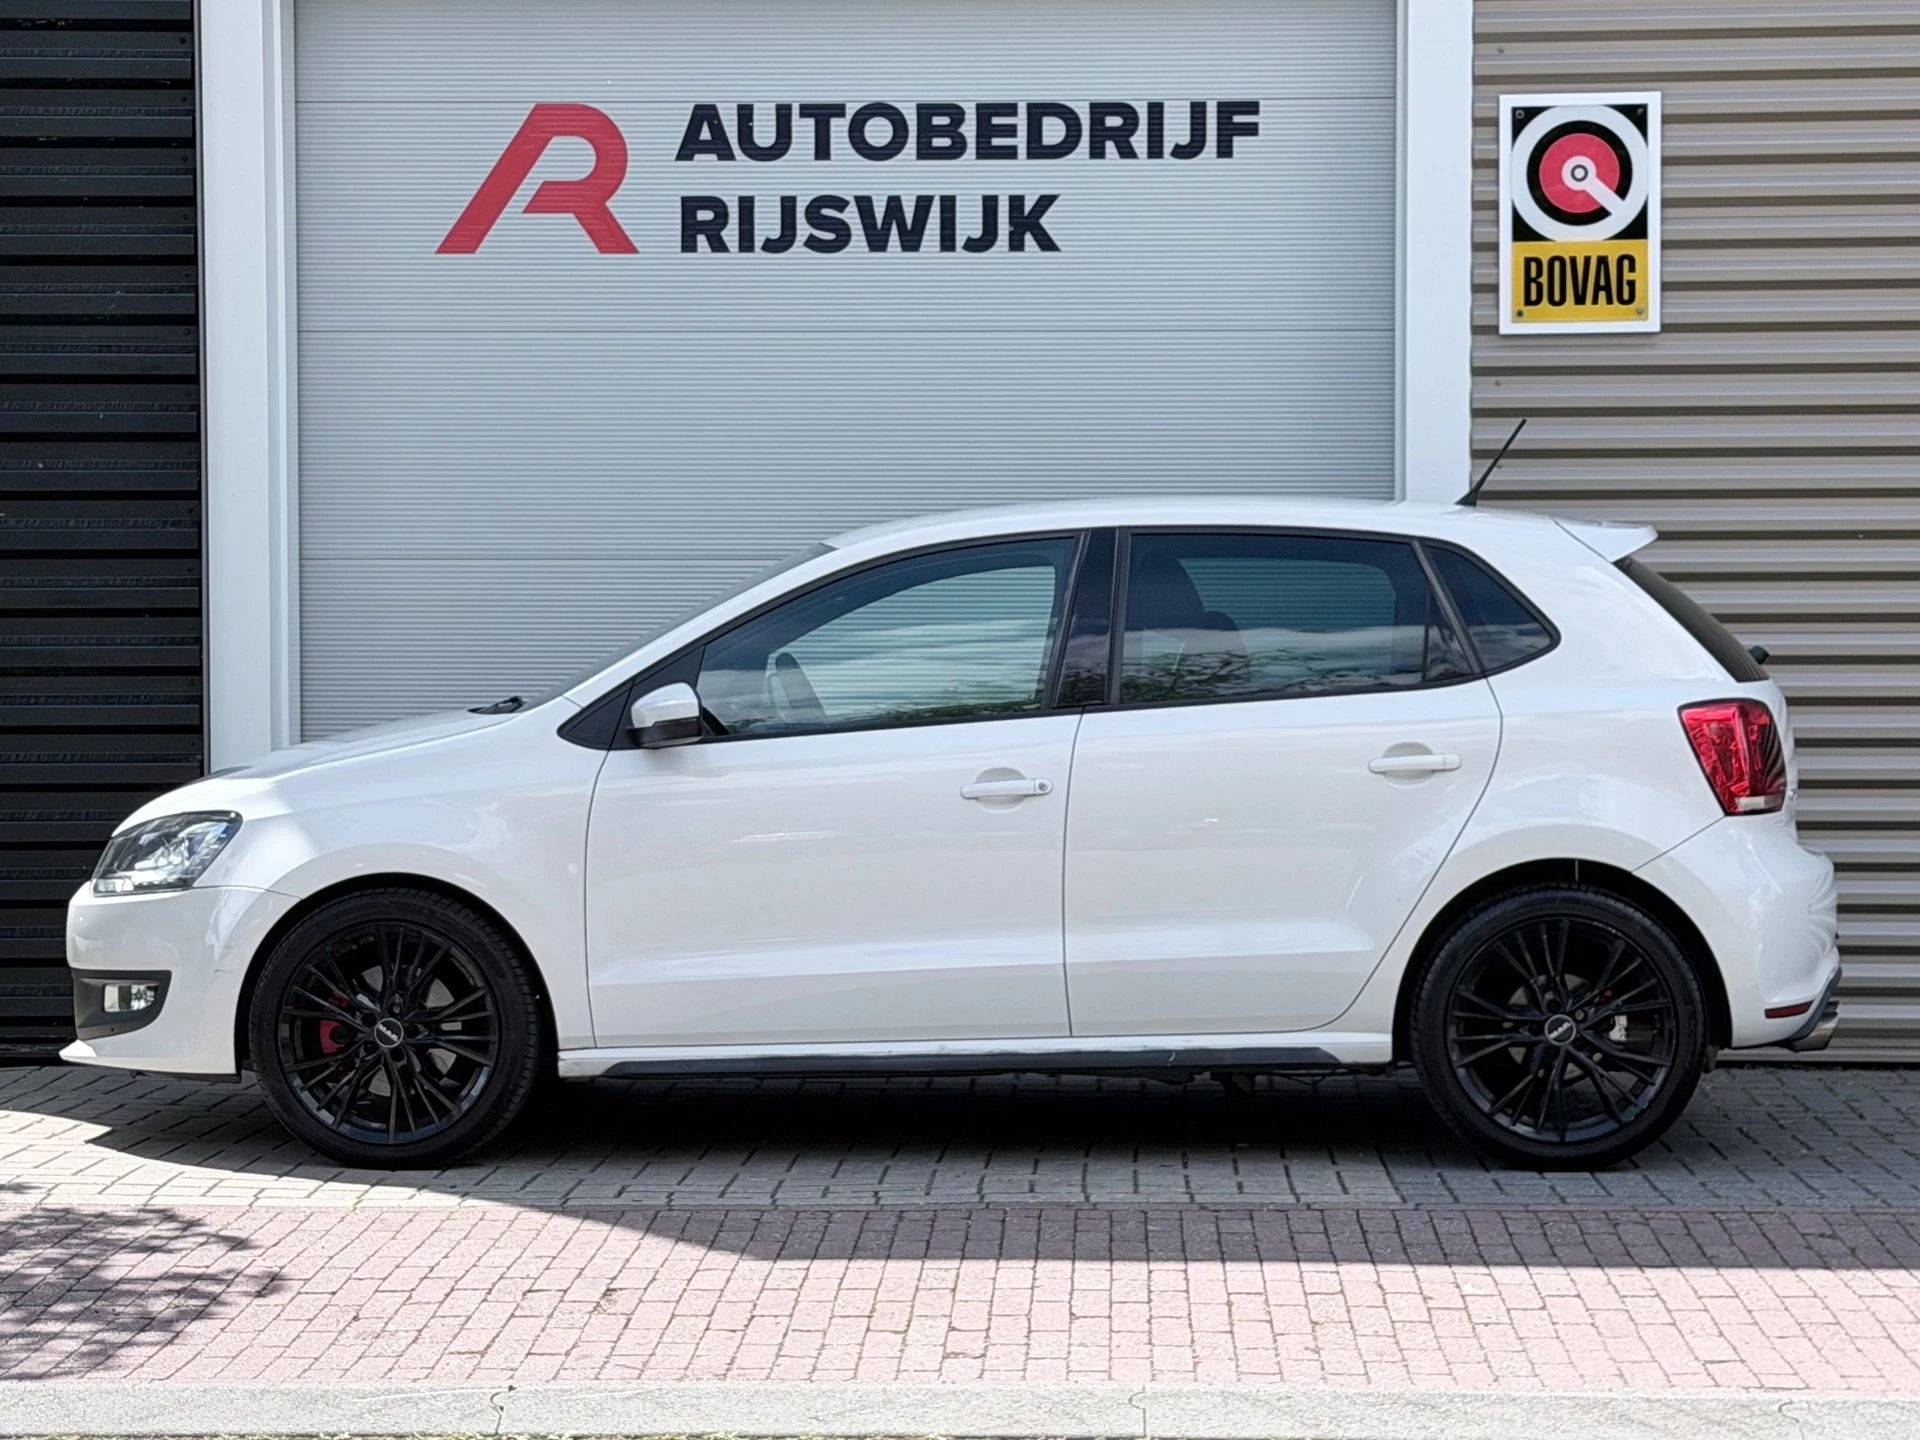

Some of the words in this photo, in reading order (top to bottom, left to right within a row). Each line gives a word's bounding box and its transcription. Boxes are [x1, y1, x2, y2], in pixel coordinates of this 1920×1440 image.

[675, 101, 1260, 162] AUTOBEDRIJF
[681, 195, 1061, 254] RIJSWIJK
[1523, 253, 1637, 308] BOVAG
